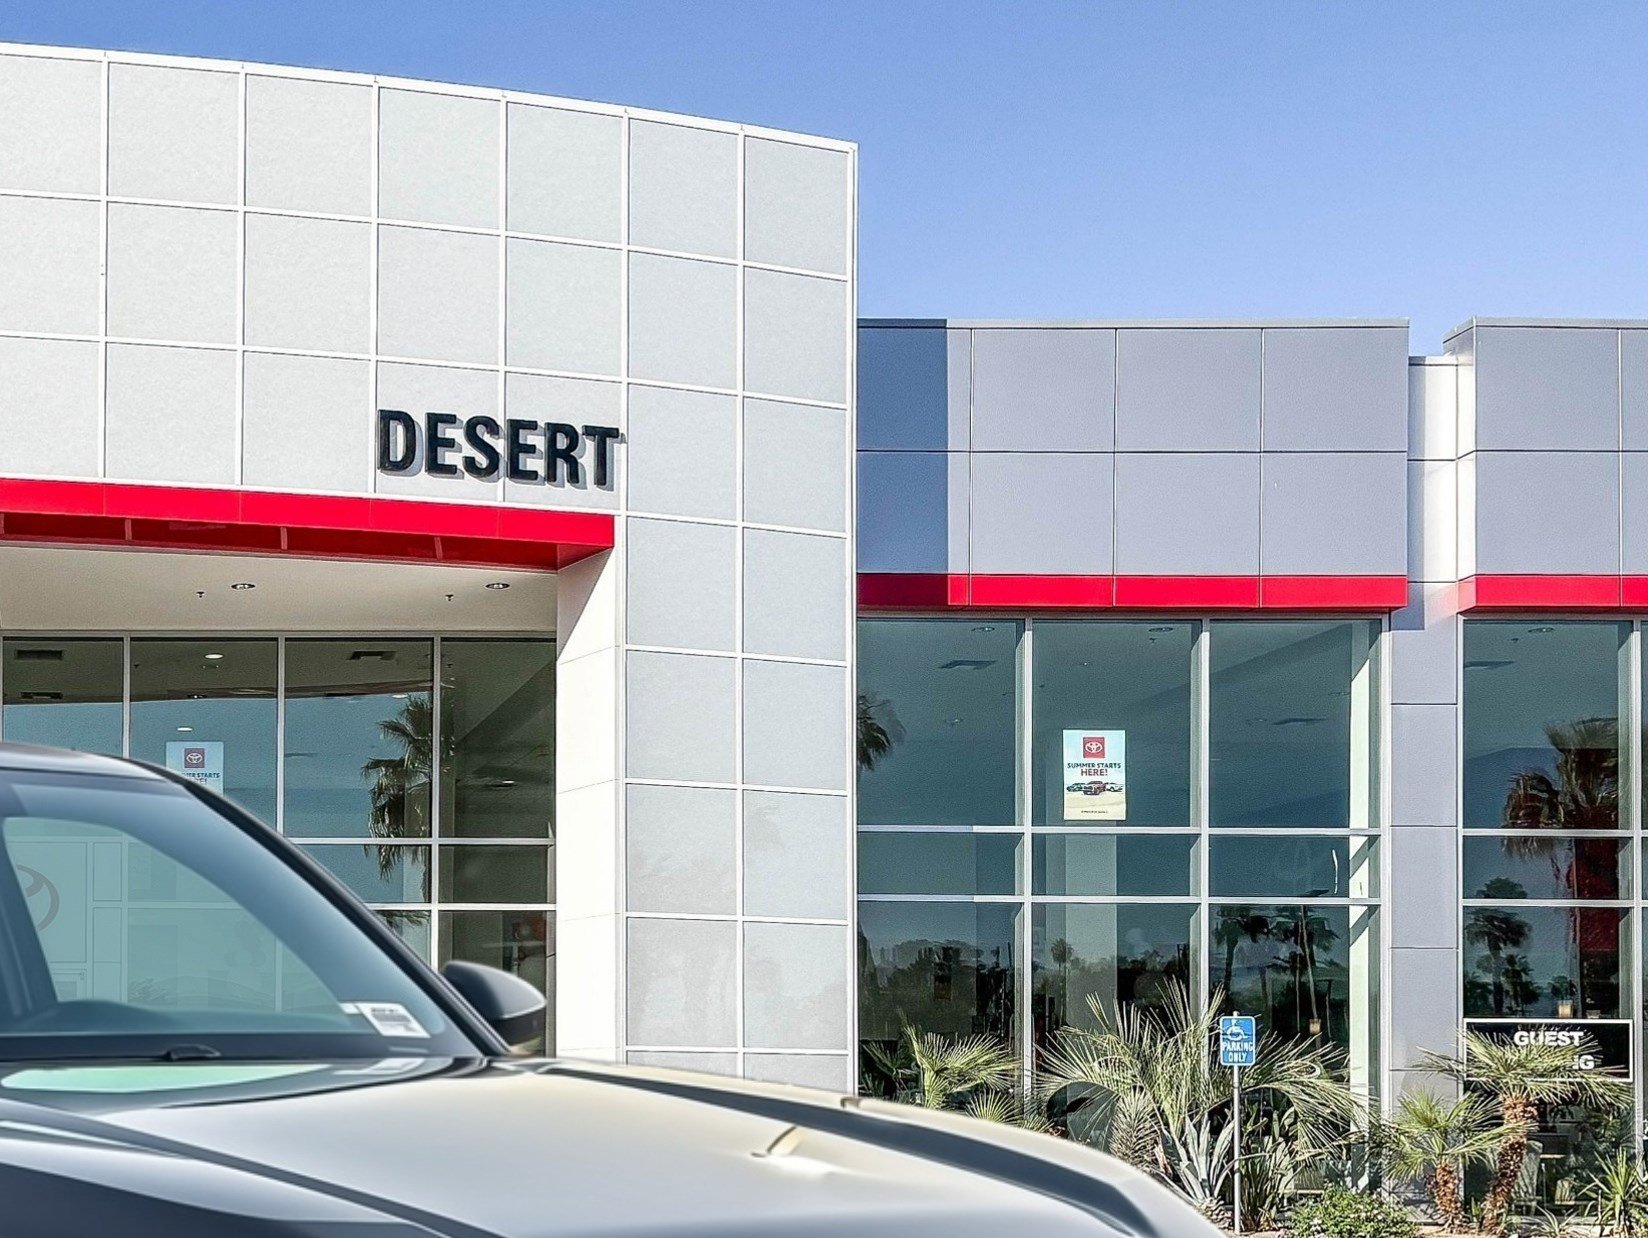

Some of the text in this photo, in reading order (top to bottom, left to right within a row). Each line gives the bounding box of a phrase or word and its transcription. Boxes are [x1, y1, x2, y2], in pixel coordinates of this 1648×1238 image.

[376, 408, 621, 488] DESERT
[1080, 768, 1108, 776] HERE!
[1513, 1030, 1584, 1047] GUEST
[1222, 1041, 1254, 1051] PARKING
[1228, 1051, 1248, 1062] ONLY
